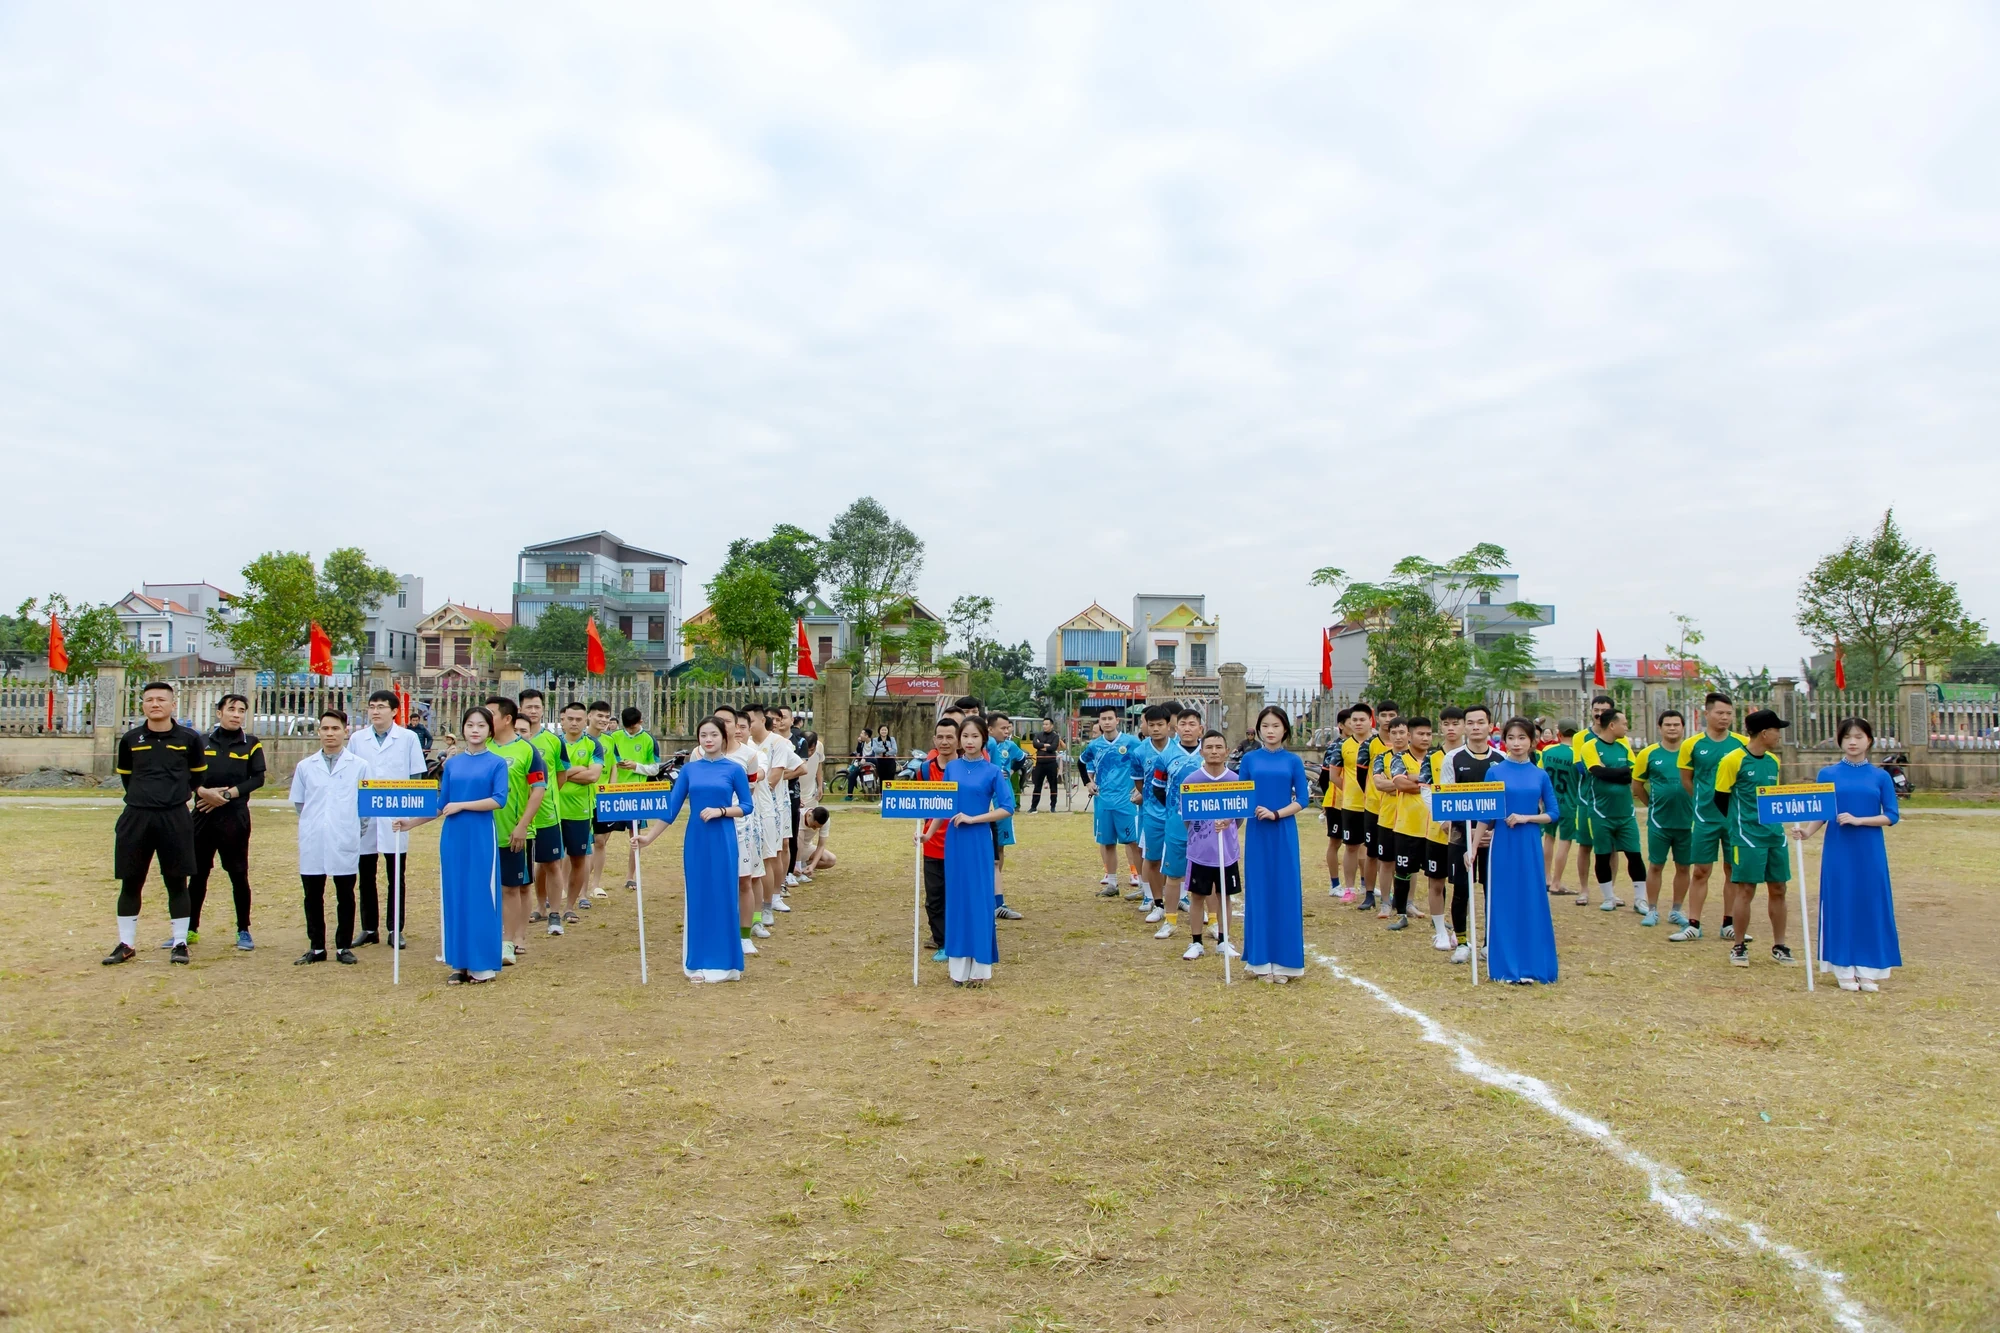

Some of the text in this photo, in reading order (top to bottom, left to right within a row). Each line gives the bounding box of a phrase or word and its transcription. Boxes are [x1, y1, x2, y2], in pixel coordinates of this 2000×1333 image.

[907, 680, 940, 688] viettel
[372, 794, 424, 808] FC BA ĐÌNH
[600, 796, 668, 812] FC CÔNG AN XÃ
[886, 795, 953, 810] FC NGA TRƯỜNG
[1188, 795, 1248, 812] FC NGA THIỆN
[1441, 798, 1496, 814] FC NGA VỊNH
[1771, 795, 1822, 816] FC VẬN TẢI
[1332, 824, 1339, 833] 9
[1343, 830, 1350, 840] 10
[1378, 844, 1383, 855] 8
[1397, 855, 1408, 867] 92
[1428, 859, 1437, 872] 19
[1232, 875, 1236, 887] 1
